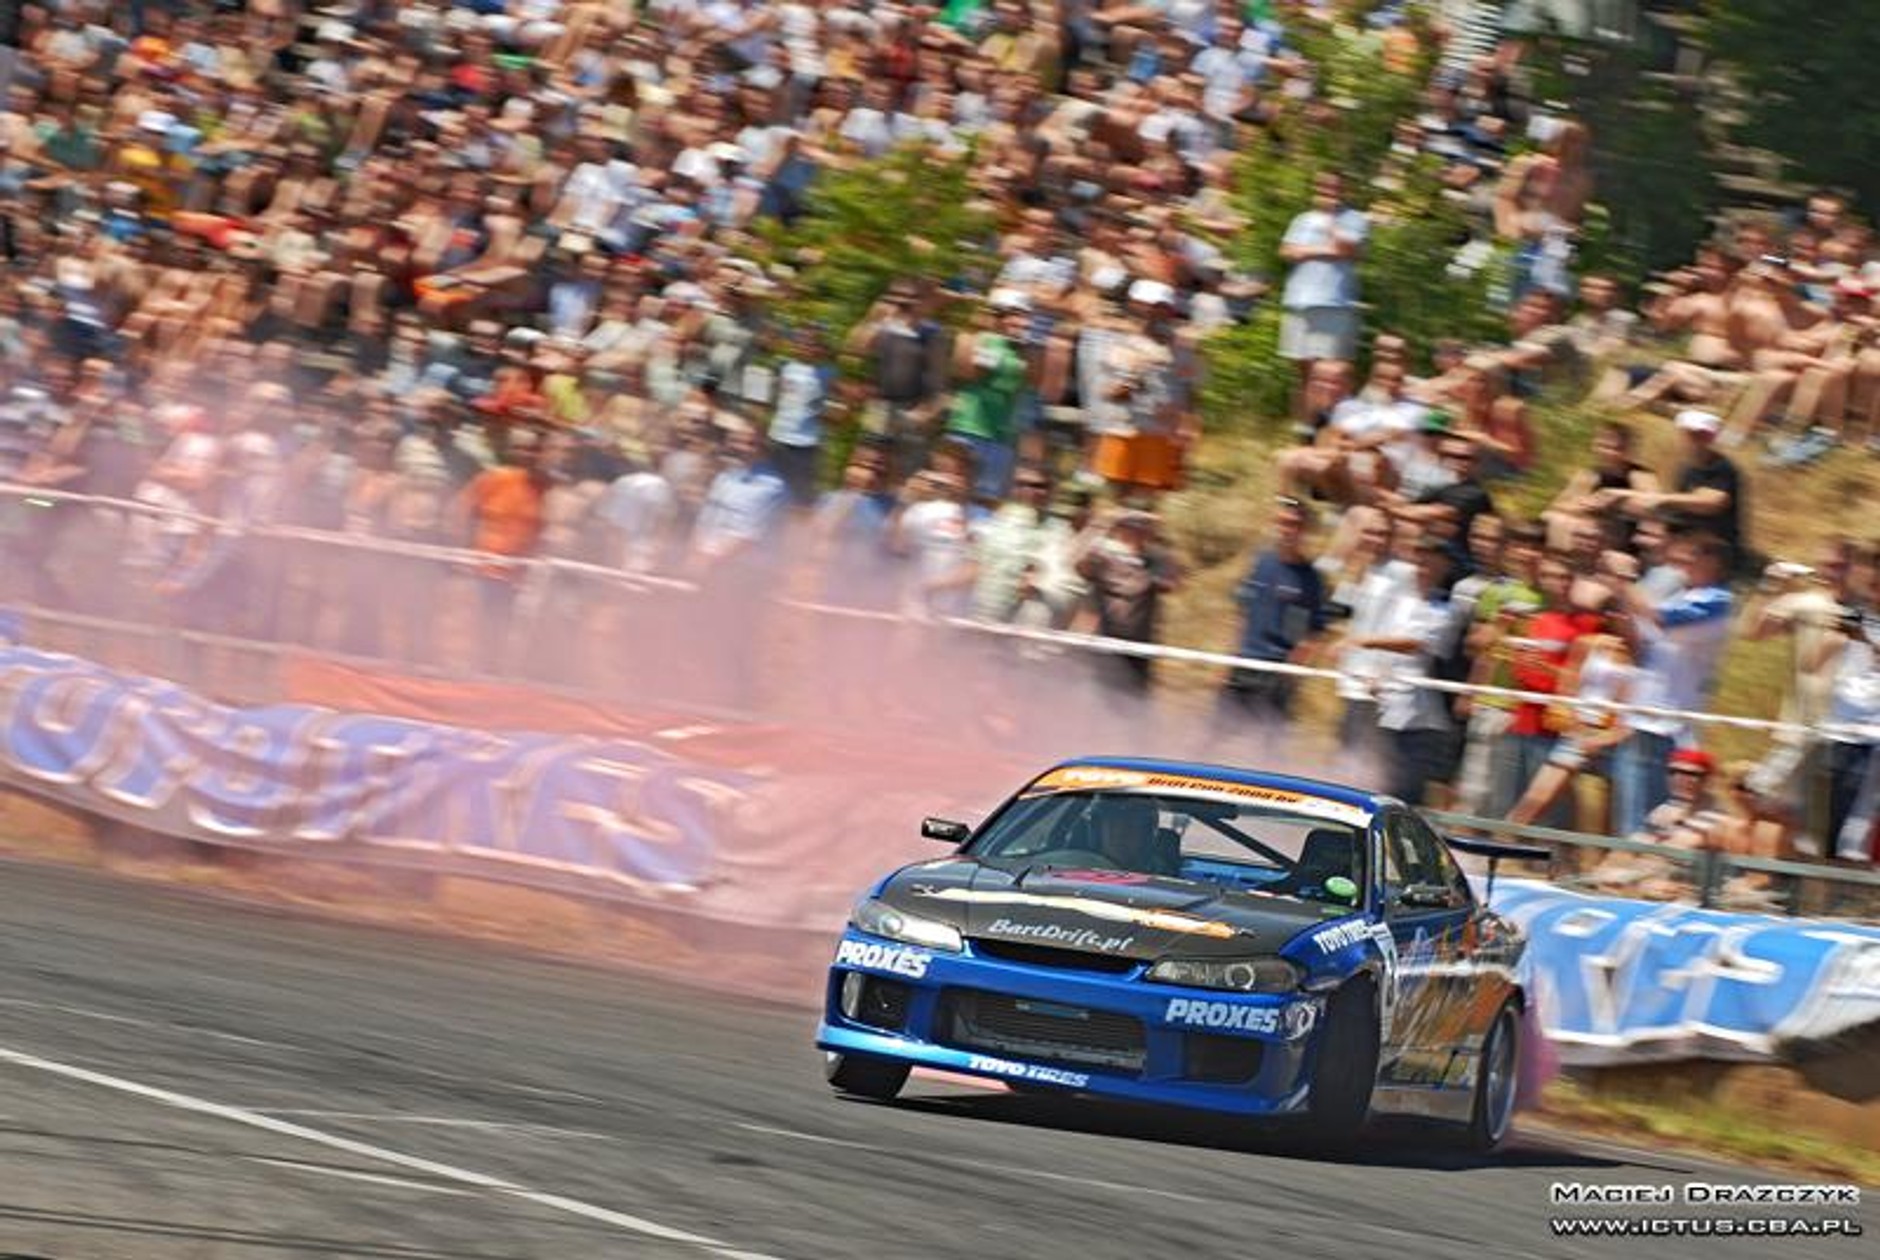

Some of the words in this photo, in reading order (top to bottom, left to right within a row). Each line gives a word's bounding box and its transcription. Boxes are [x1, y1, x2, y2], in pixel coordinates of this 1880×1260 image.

[988, 917, 1134, 950] BartDrift.pl
[836, 940, 932, 978] PROXES
[1165, 998, 1280, 1034] PROXES
[968, 1055, 1027, 1076] TOYO
[1026, 1064, 1090, 1088] TIRES
